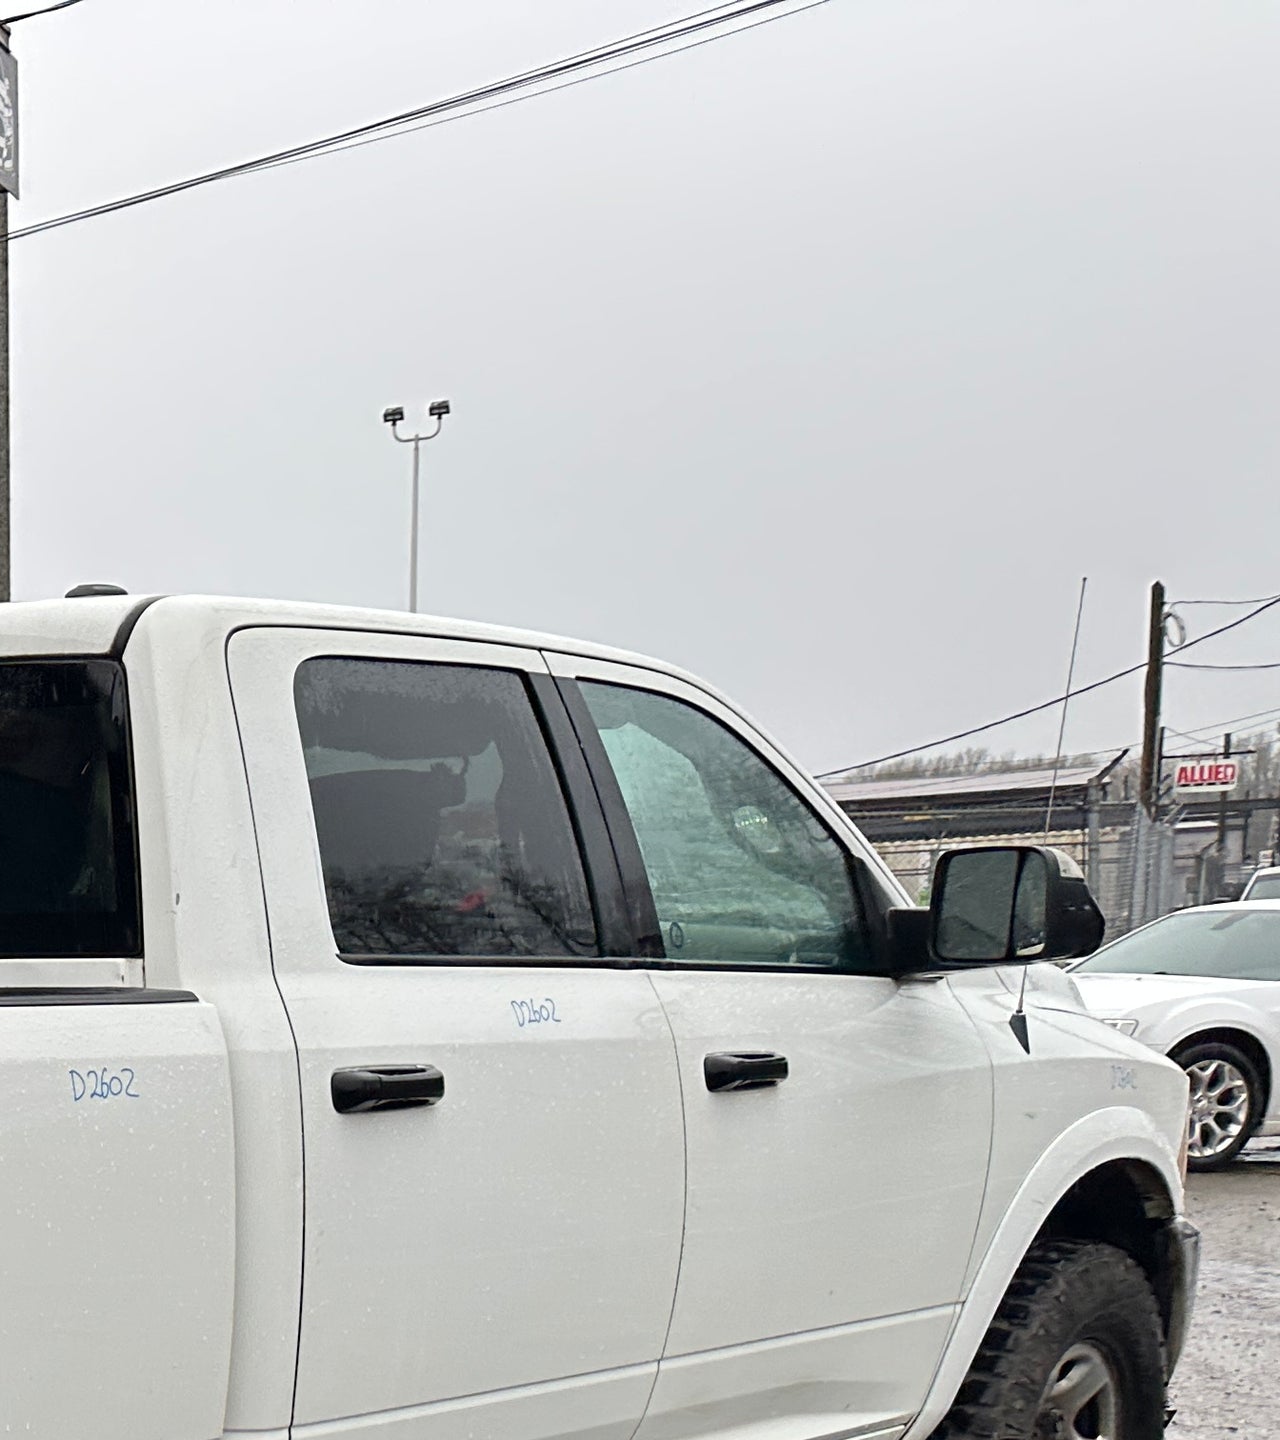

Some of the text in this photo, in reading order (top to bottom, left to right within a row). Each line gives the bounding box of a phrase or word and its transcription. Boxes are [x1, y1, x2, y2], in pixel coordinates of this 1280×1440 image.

[1177, 764, 1236, 783] ALLIED
[511, 998, 562, 1028] D2602
[68, 1067, 140, 1101] D2602
